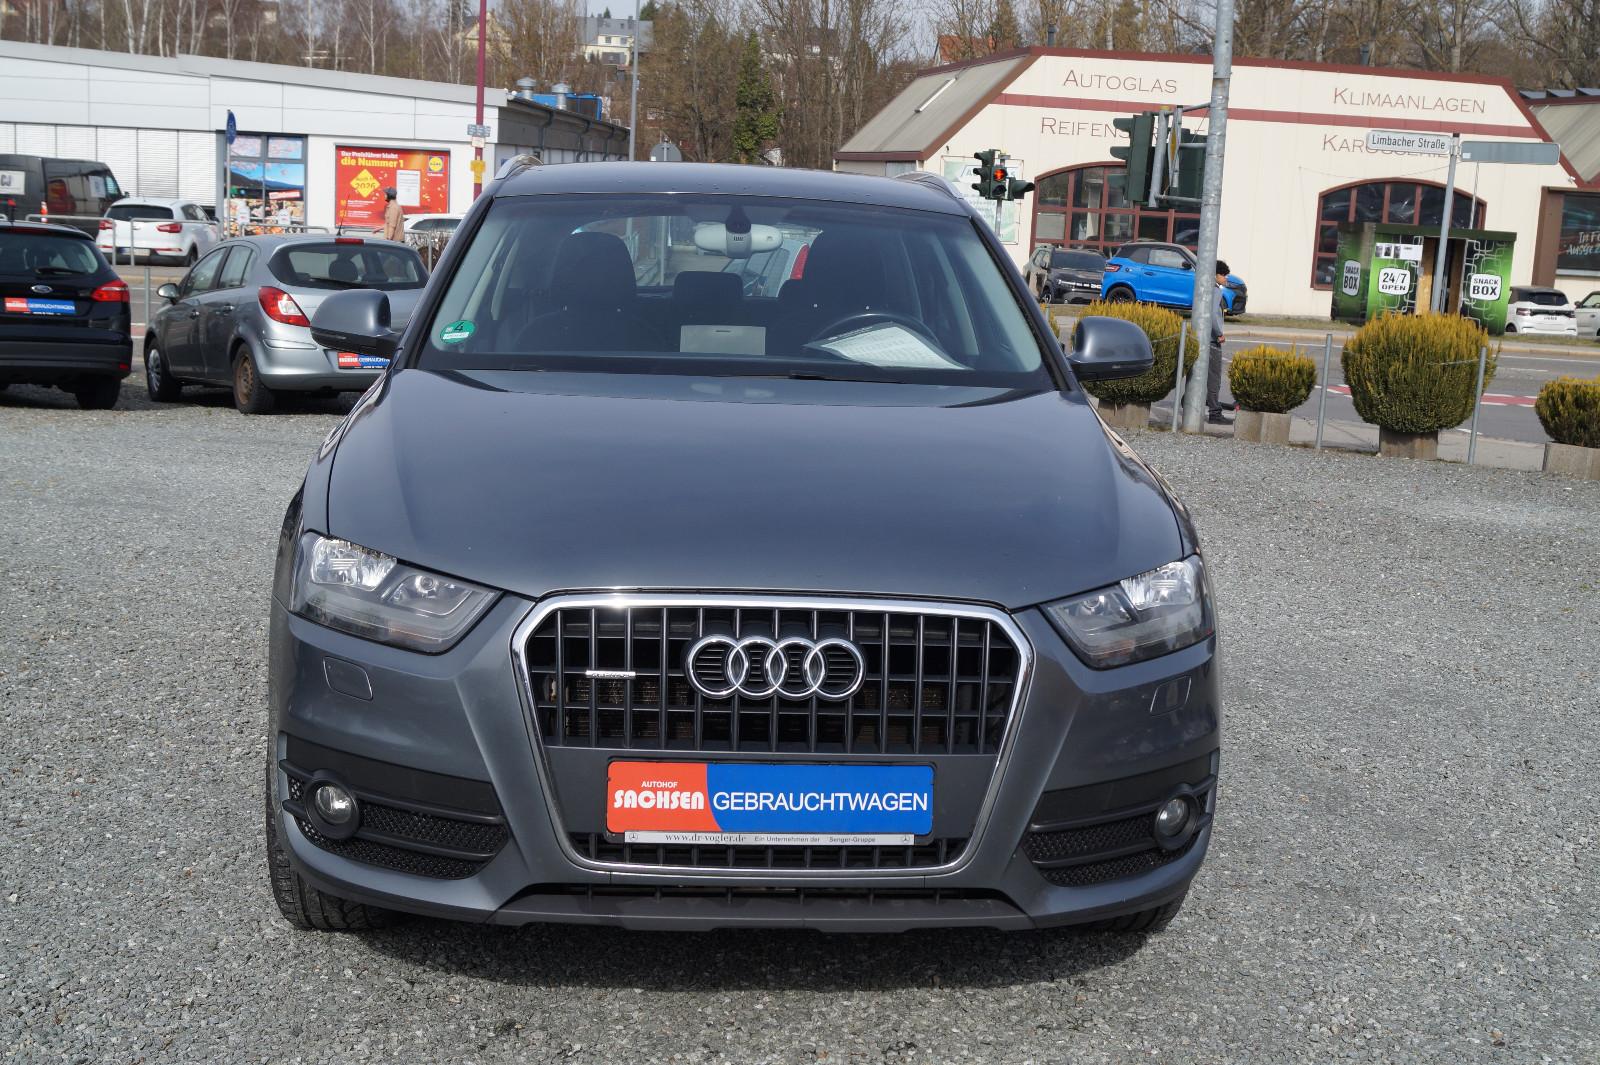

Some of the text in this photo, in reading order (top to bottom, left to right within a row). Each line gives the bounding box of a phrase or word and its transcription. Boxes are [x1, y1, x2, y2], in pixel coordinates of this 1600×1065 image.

[1063, 69, 1177, 94] AUTOGLAS
[1333, 87, 1486, 114] KLIMAANLAGEN
[1371, 134, 1415, 148] Limbacher
[1417, 137, 1446, 150] Straße
[341, 156, 404, 168] die Nummer 1
[1344, 275, 1358, 289] BOX
[1382, 272, 1407, 284] 24/7
[1473, 278, 1498, 286] SNACK
[1472, 285, 1497, 296] BOX
[454, 321, 464, 331] 4
[641, 780, 678, 789] AUTOHOF
[613, 789, 929, 811] SACHSEN GEBRAUCHTWAGEN
[766, 835, 809, 843] Unternehmen
